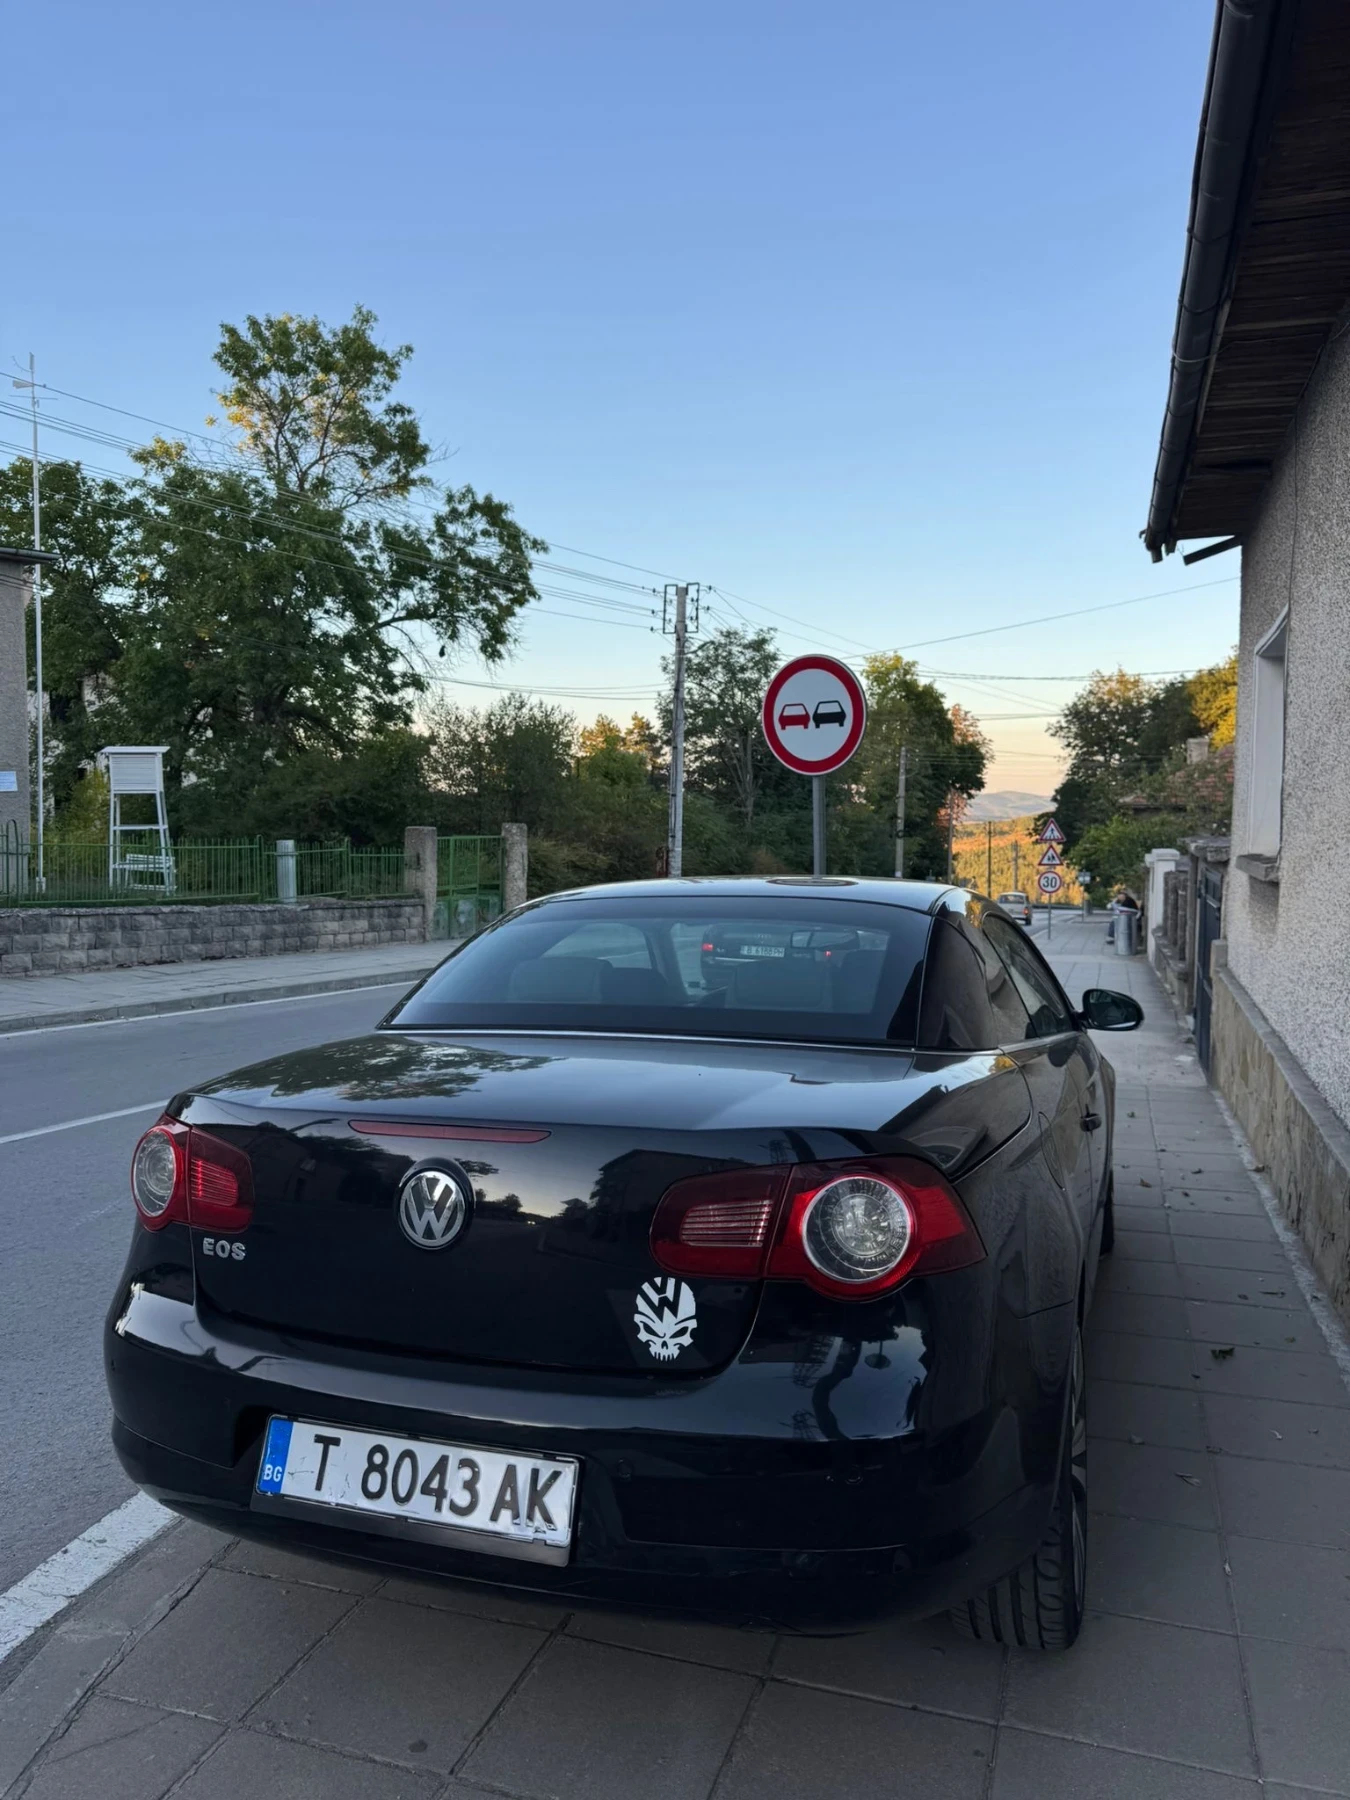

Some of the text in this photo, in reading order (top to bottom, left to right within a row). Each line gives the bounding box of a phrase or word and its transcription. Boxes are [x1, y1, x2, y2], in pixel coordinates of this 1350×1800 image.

[1042, 876, 1058, 888] 30
[202, 1237, 247, 1261] EOS
[263, 1464, 283, 1483] BG
[313, 1434, 562, 1531] T 8043 AK
